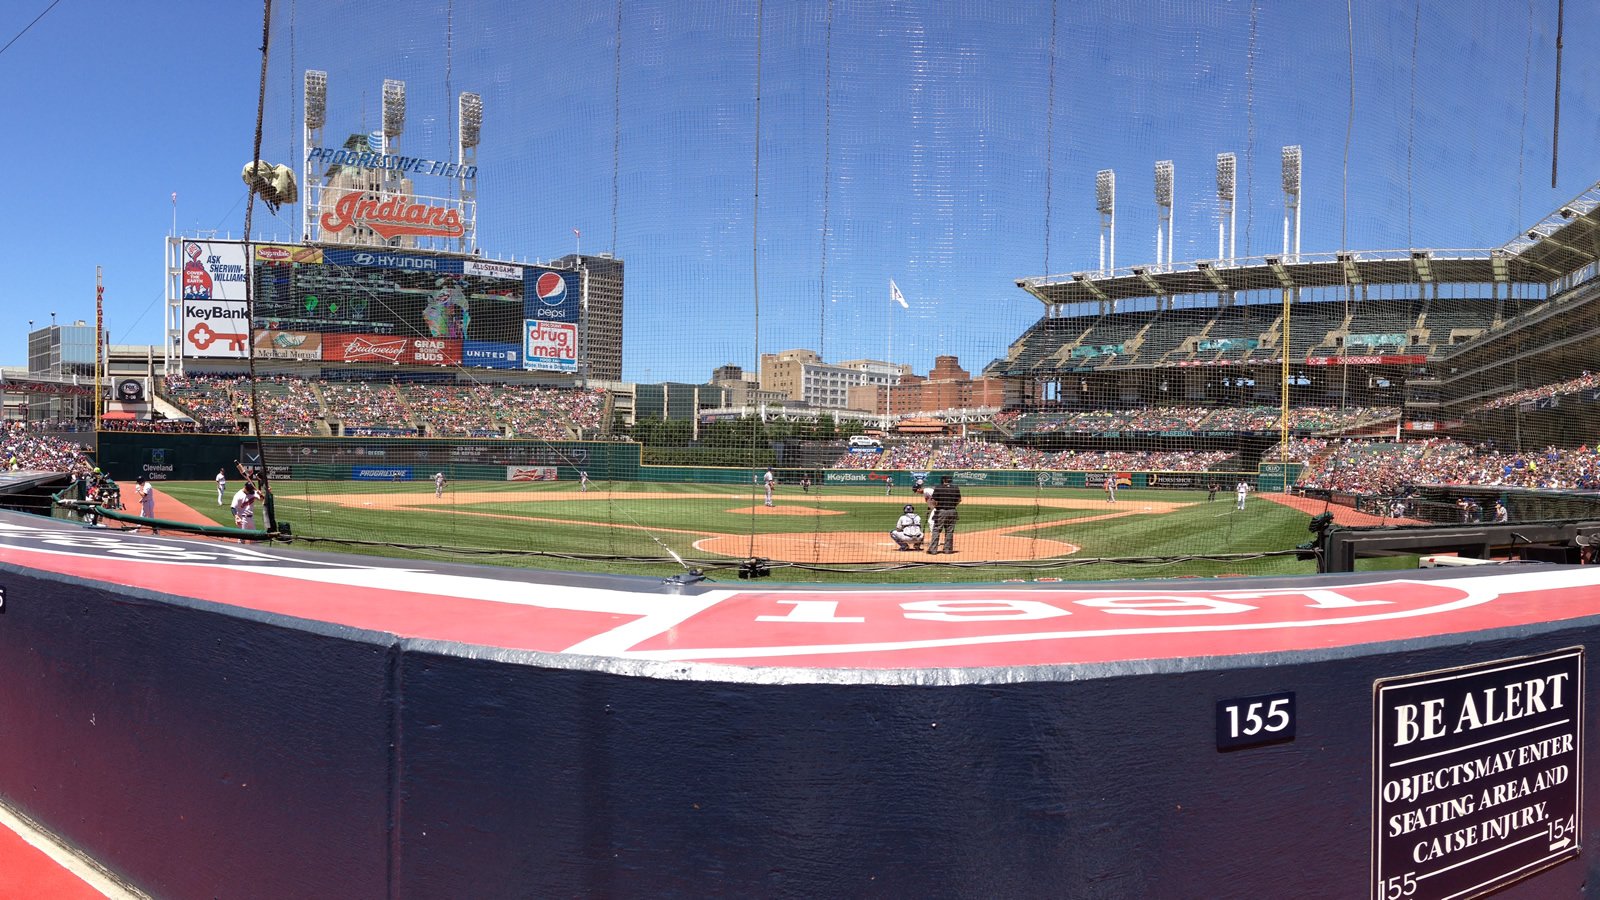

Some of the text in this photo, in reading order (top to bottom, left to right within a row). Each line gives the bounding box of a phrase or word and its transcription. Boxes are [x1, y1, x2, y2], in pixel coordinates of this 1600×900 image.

[307, 147, 478, 180] PROGRESSIVE FIELD
[320, 191, 464, 239] Indians
[207, 255, 222, 264] ASK
[378, 255, 436, 269] HYUNDAI
[209, 264, 244, 273] SHERWIN-
[499, 266, 516, 274] GAME
[213, 272, 248, 283] WILLIAMS
[96, 286, 105, 353] WALGREENS
[186, 305, 249, 321] KeyBank
[537, 308, 566, 318] pepsi
[530, 322, 567, 347] drug
[343, 342, 406, 355] Budweiser
[414, 340, 445, 349] GRAB
[258, 350, 318, 359] Medical Mutual
[414, 353, 444, 361] BUDS
[466, 351, 505, 359] UNITED
[533, 345, 573, 358] mart
[149, 472, 167, 480] Clinic
[828, 473, 867, 482] KeyBank
[953, 471, 988, 480] FirstEnergy
[754, 589, 1398, 623] 1997
[1394, 672, 1569, 747] BE ALERT
[1225, 698, 1290, 738] 155
[1518, 733, 1574, 767] ENTER
[1389, 764, 1569, 838] SEATING AREA AND
[1413, 801, 1550, 864] CAUSE INJURY.
[1547, 814, 1576, 842] 154
[1379, 871, 1417, 900] 155
